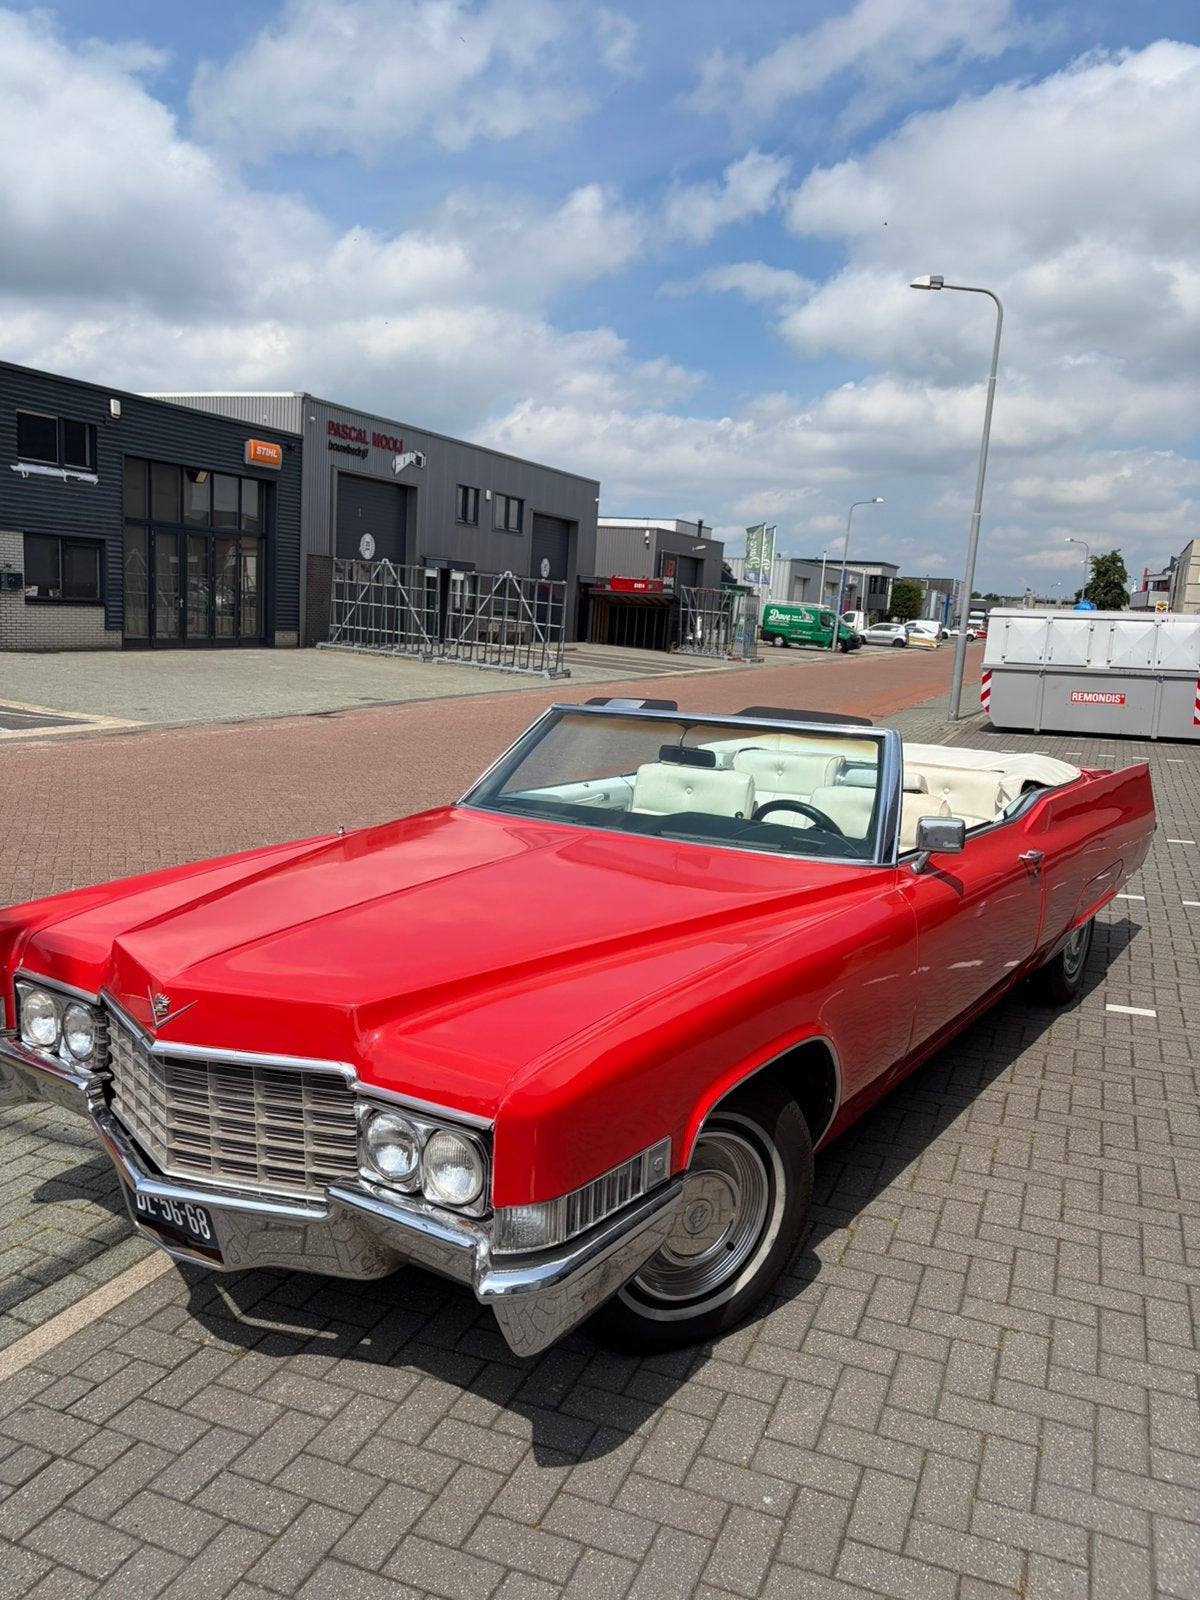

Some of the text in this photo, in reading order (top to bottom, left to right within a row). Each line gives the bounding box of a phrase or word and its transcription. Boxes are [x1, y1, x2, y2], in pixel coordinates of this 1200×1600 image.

[328, 420, 369, 445] PASCAL
[256, 446, 278, 458] STIHL
[769, 609, 791, 622] Dave
[1071, 692, 1121, 704] REMONDIS
